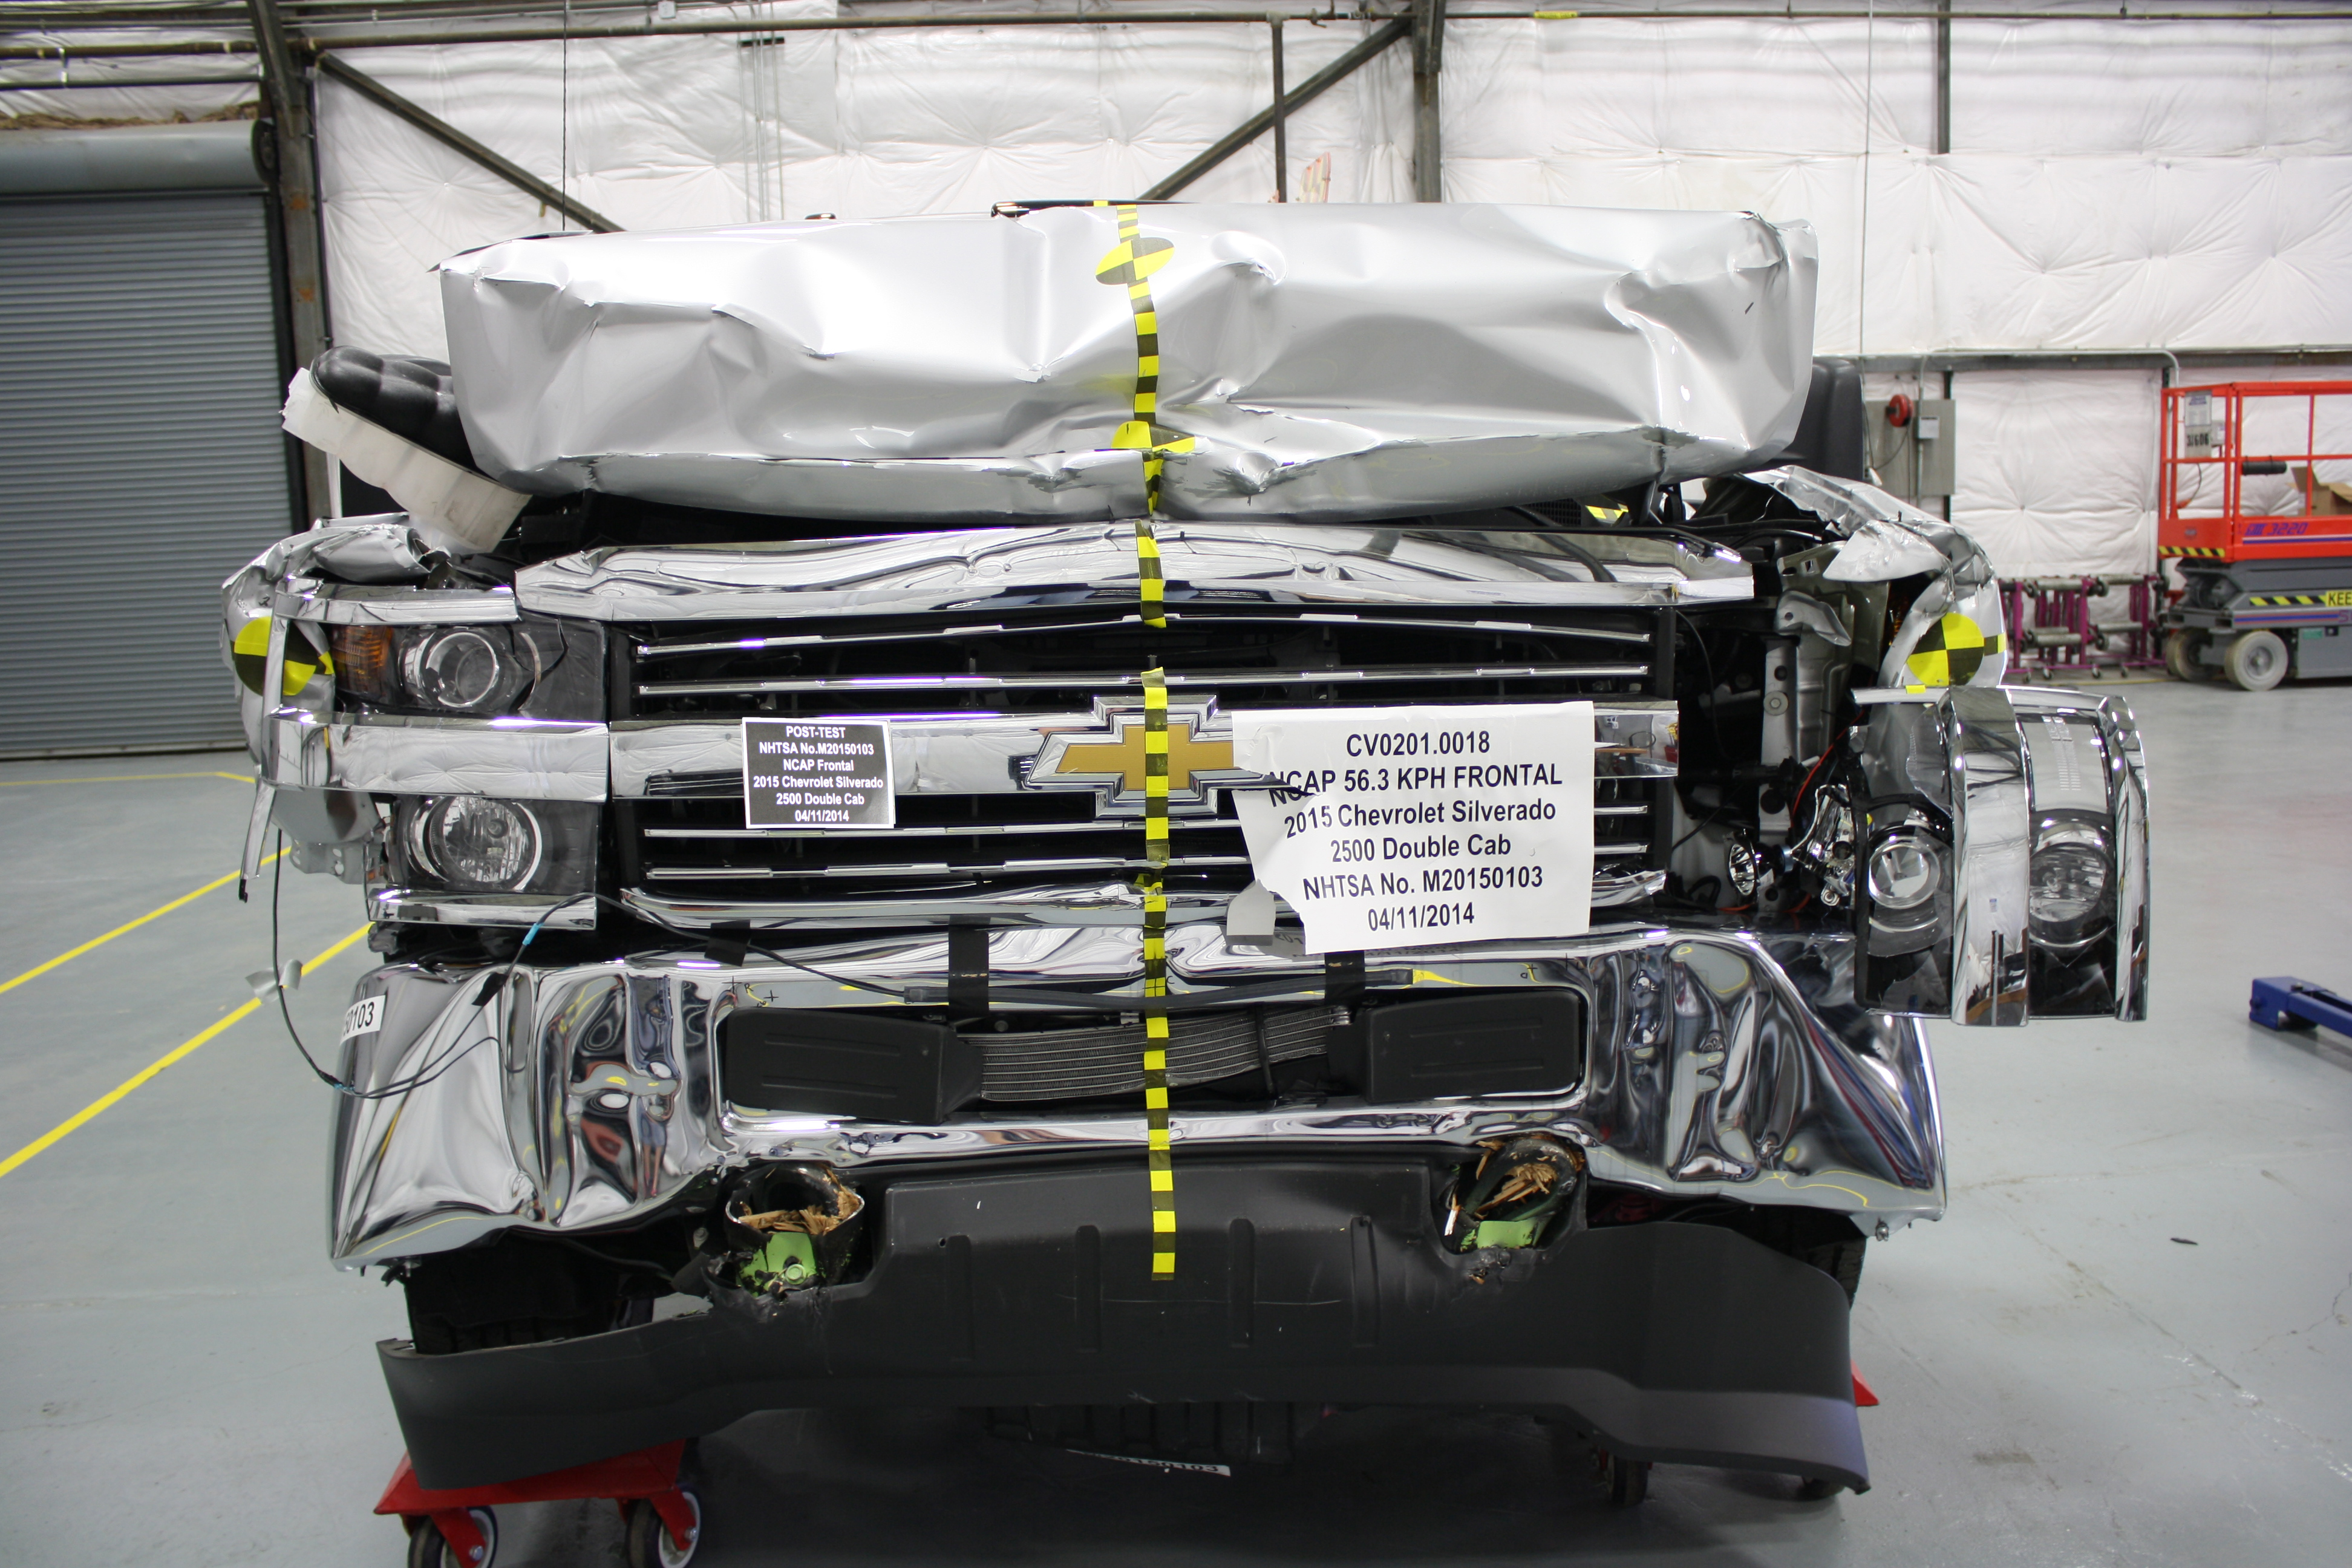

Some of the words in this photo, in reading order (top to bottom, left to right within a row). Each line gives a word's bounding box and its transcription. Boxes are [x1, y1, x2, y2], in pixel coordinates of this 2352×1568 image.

[2267, 522, 2308, 536] 3220
[786, 725, 846, 739] POST-TEST
[759, 742, 799, 754] NHTSA
[800, 742, 875, 755] No.M20150103
[1346, 730, 1491, 757] CV0201.0018
[783, 759, 815, 771] NCAP
[817, 759, 854, 771] Frontal
[753, 776, 779, 788] 2015
[782, 776, 834, 788] Chevrolet
[835, 776, 884, 788] Silverado
[1269, 769, 1336, 807] NCAP
[1344, 769, 1390, 792] 56.3
[1397, 768, 1446, 790] KPH
[1454, 763, 1563, 788] FRONTAL
[776, 792, 802, 805] 2500
[805, 792, 841, 805] Double
[844, 793, 864, 805] Cab
[794, 809, 849, 822] 04/11/2014
[1284, 805, 1332, 838] 2015
[1338, 802, 1445, 827] Chevrolet
[1452, 798, 1556, 822] Silverado
[1330, 839, 1374, 862] 2500
[1383, 834, 1459, 860] Double
[1467, 833, 1511, 855] Cab
[1303, 873, 1374, 900] NHTSA
[1380, 873, 1415, 895] No.
[1422, 866, 1543, 892] M20150103
[1368, 902, 1474, 931] 04/11/2014
